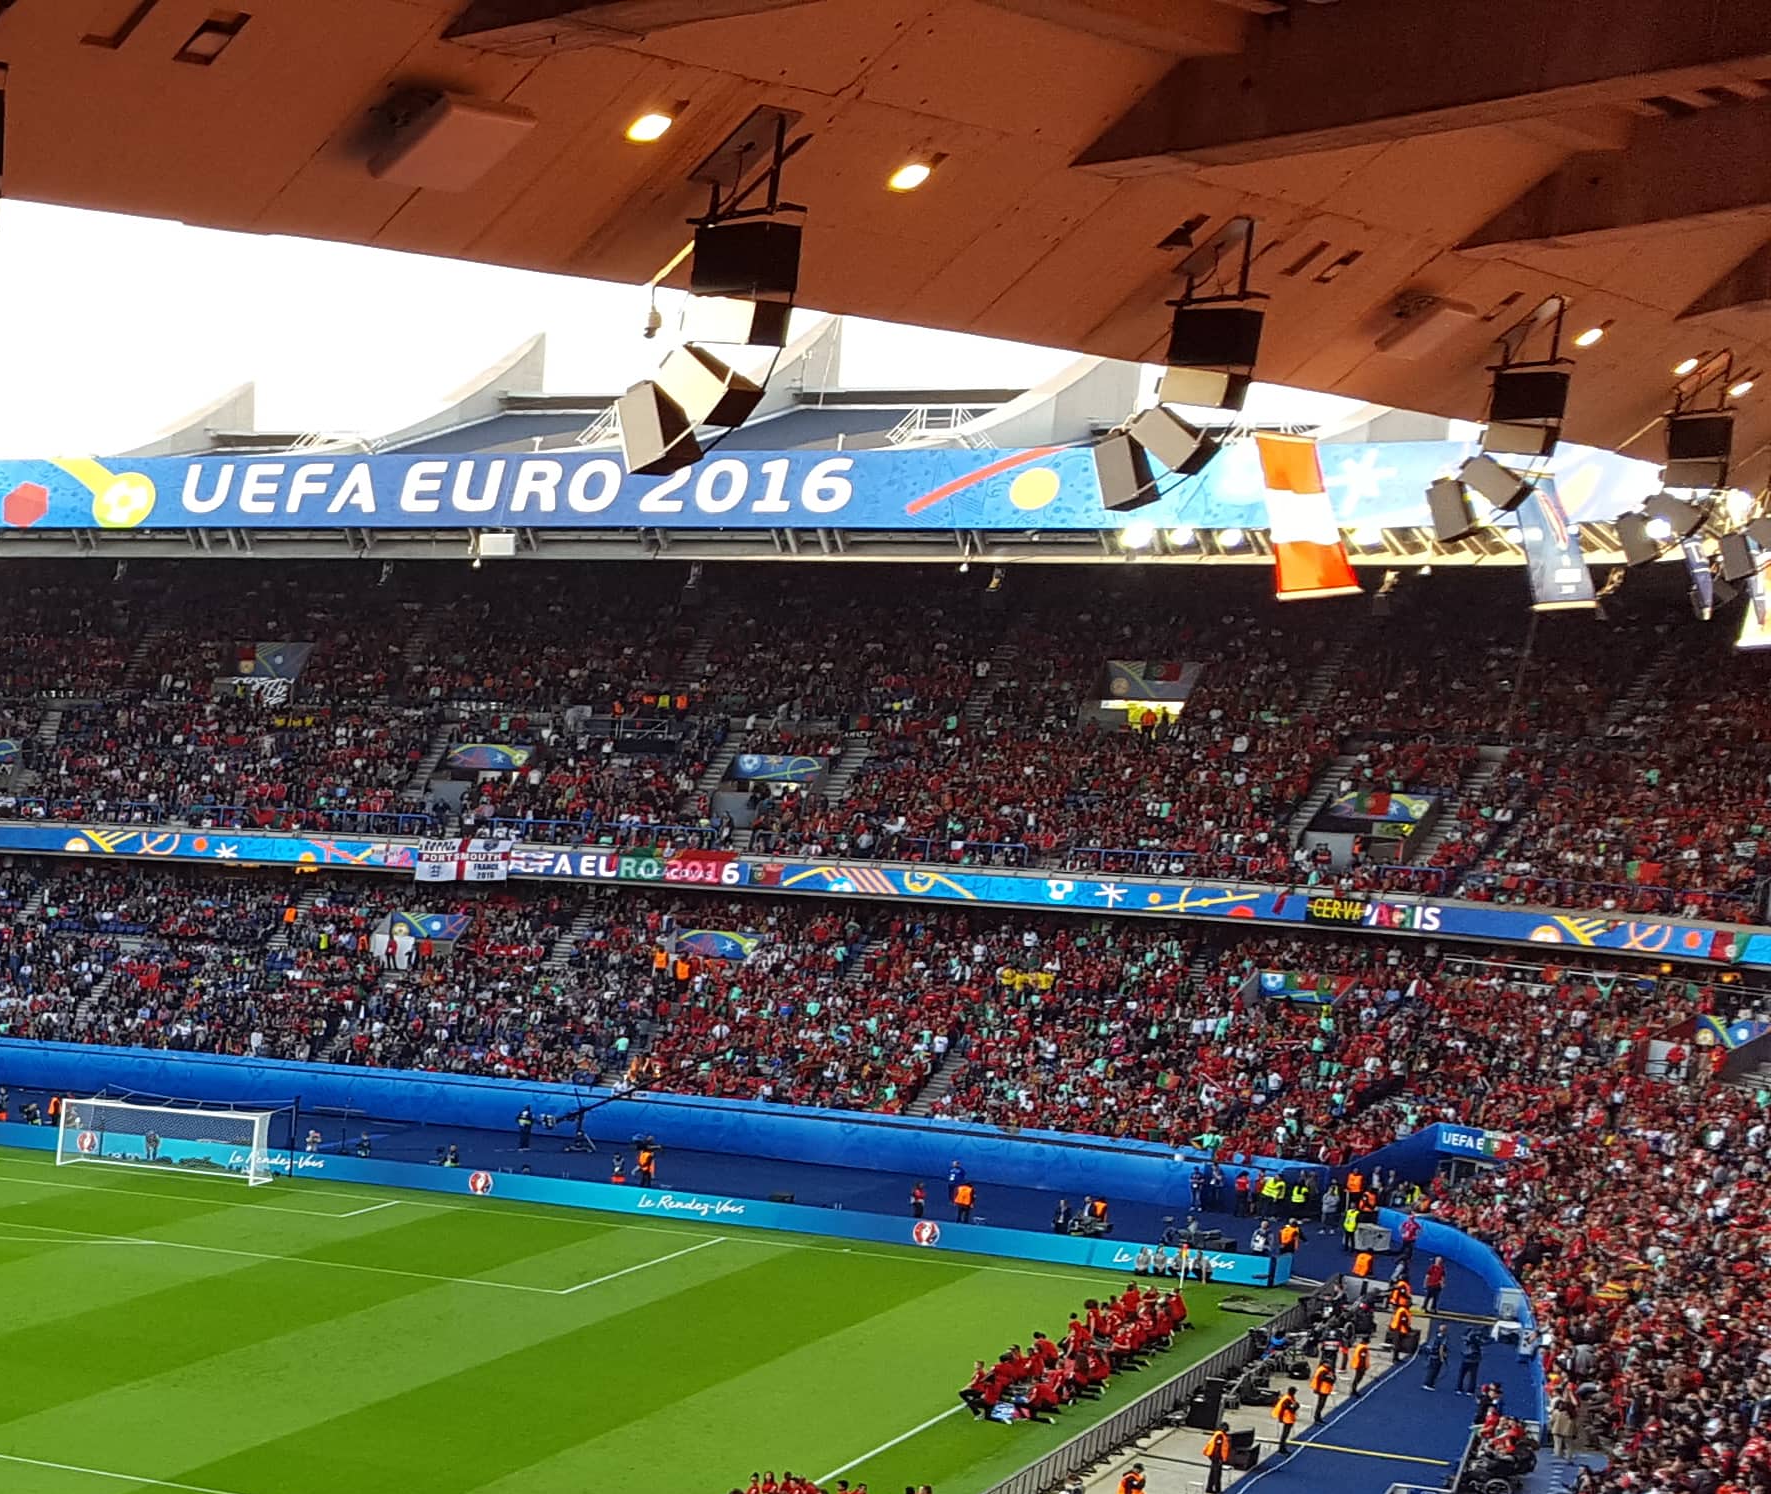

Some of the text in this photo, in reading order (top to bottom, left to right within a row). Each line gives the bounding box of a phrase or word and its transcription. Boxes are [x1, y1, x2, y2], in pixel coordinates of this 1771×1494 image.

[180, 457, 854, 514] UEFA EURO 2016
[422, 852, 502, 862] PORTSMOUTH
[580, 855, 659, 880] EURO
[664, 859, 740, 884] 2016
[1442, 1132, 1474, 1149] UEFA
[227, 1150, 244, 1164] Le
[637, 1193, 746, 1216] Le Rendez-Vous
[1113, 1247, 1133, 1263] Le
